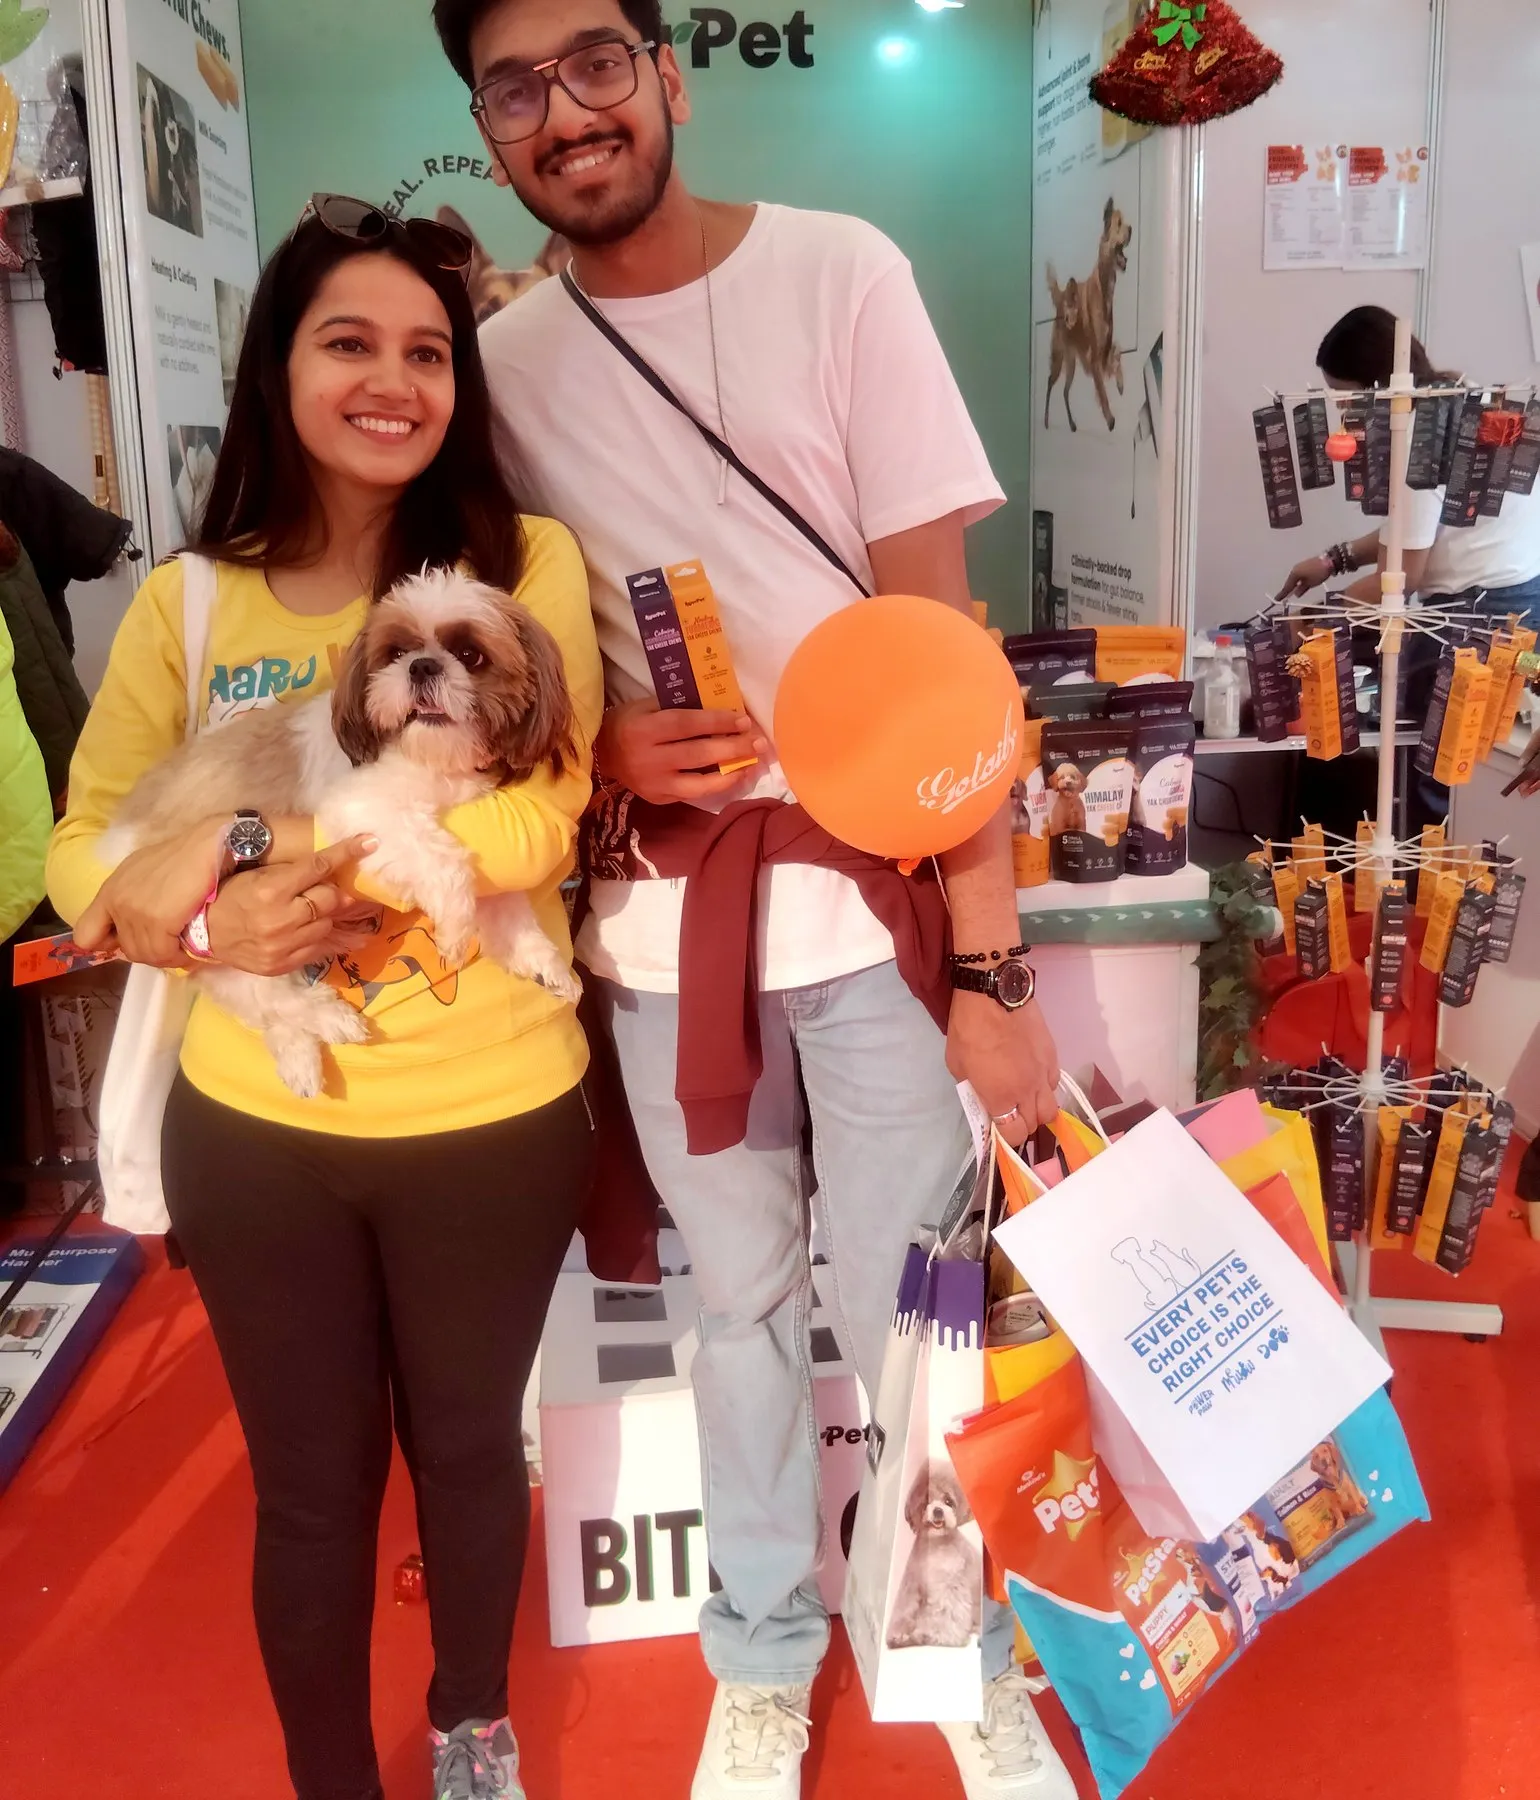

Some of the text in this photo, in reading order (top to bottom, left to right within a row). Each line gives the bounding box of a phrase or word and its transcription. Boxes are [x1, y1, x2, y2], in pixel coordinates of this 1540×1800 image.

[383, 178, 424, 218] EAL.
[423, 154, 495, 182] REPEA
[1131, 1257, 1248, 1357] EVERY PET'S
[1148, 1274, 1263, 1374] CHOICE IS THE
[1162, 1292, 1275, 1393] RIGHT CHOICE
[820, 1422, 872, 1448] Pet
[579, 1508, 723, 1607] BIT
